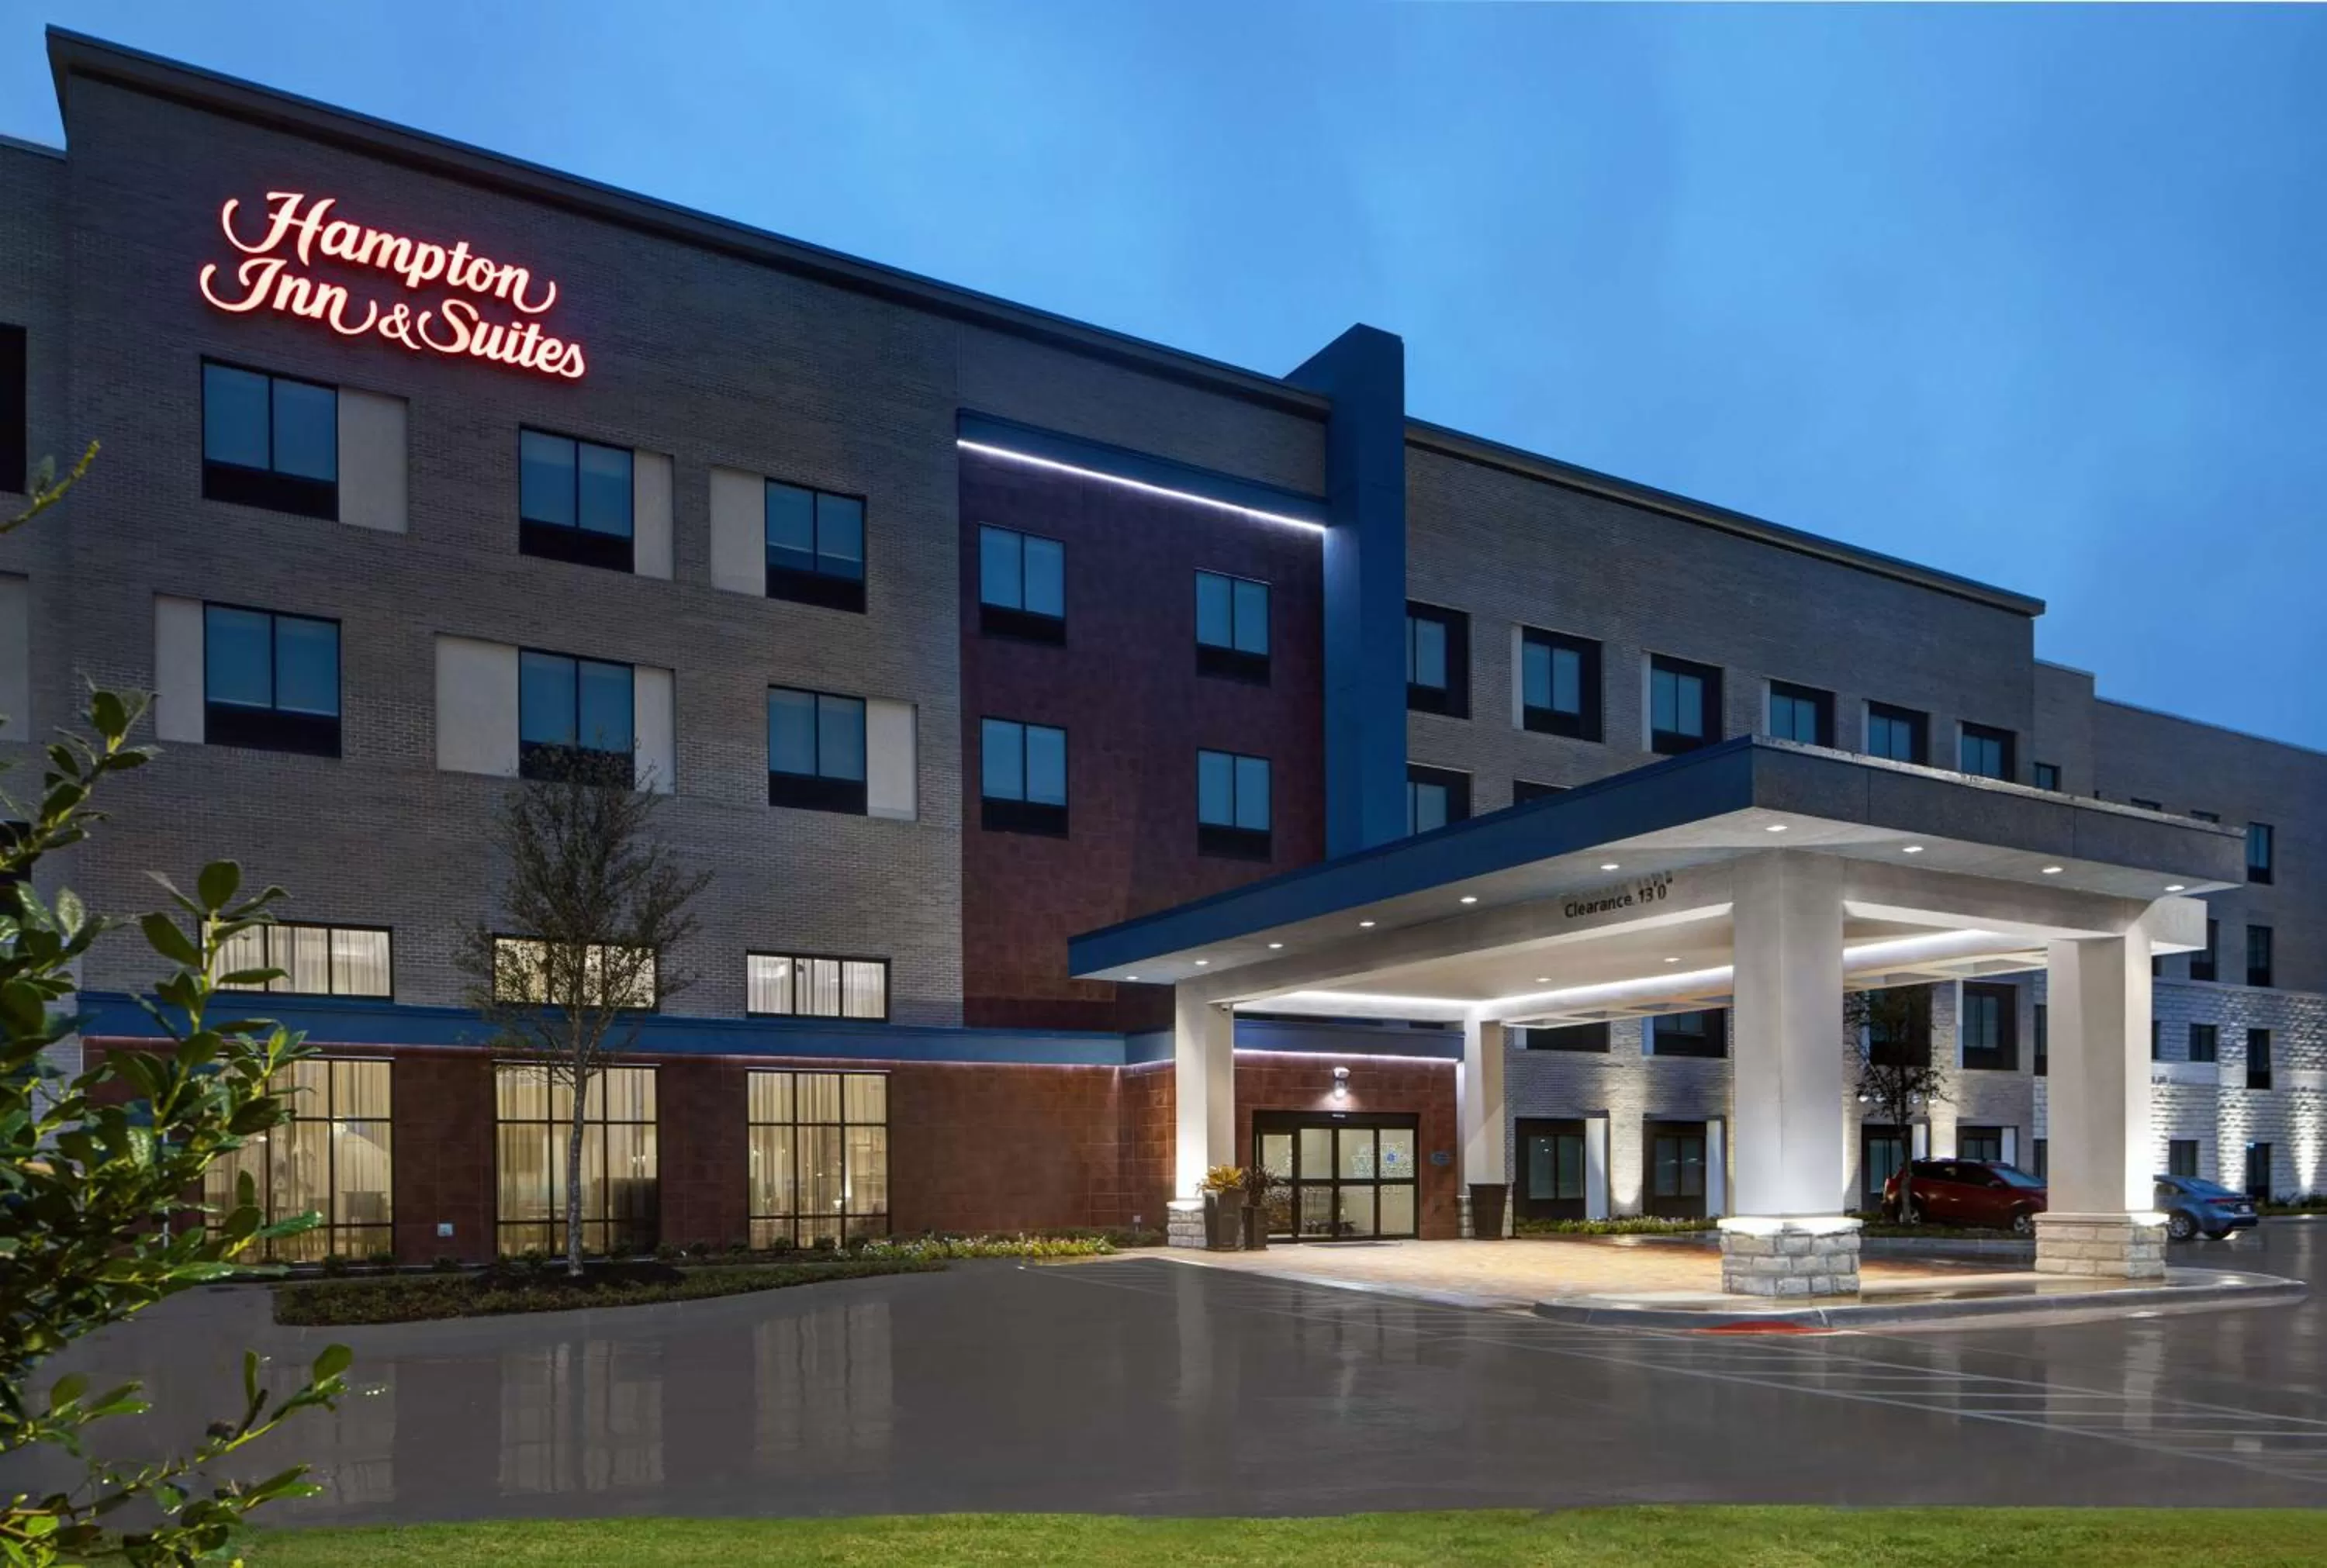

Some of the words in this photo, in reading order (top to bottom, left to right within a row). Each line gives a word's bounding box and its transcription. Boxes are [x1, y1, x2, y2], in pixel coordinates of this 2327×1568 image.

[222, 191, 556, 313] Hampton
[199, 257, 378, 335] Inn
[378, 303, 421, 351] &
[417, 299, 586, 378] Suites
[1564, 894, 1633, 918] Clearance
